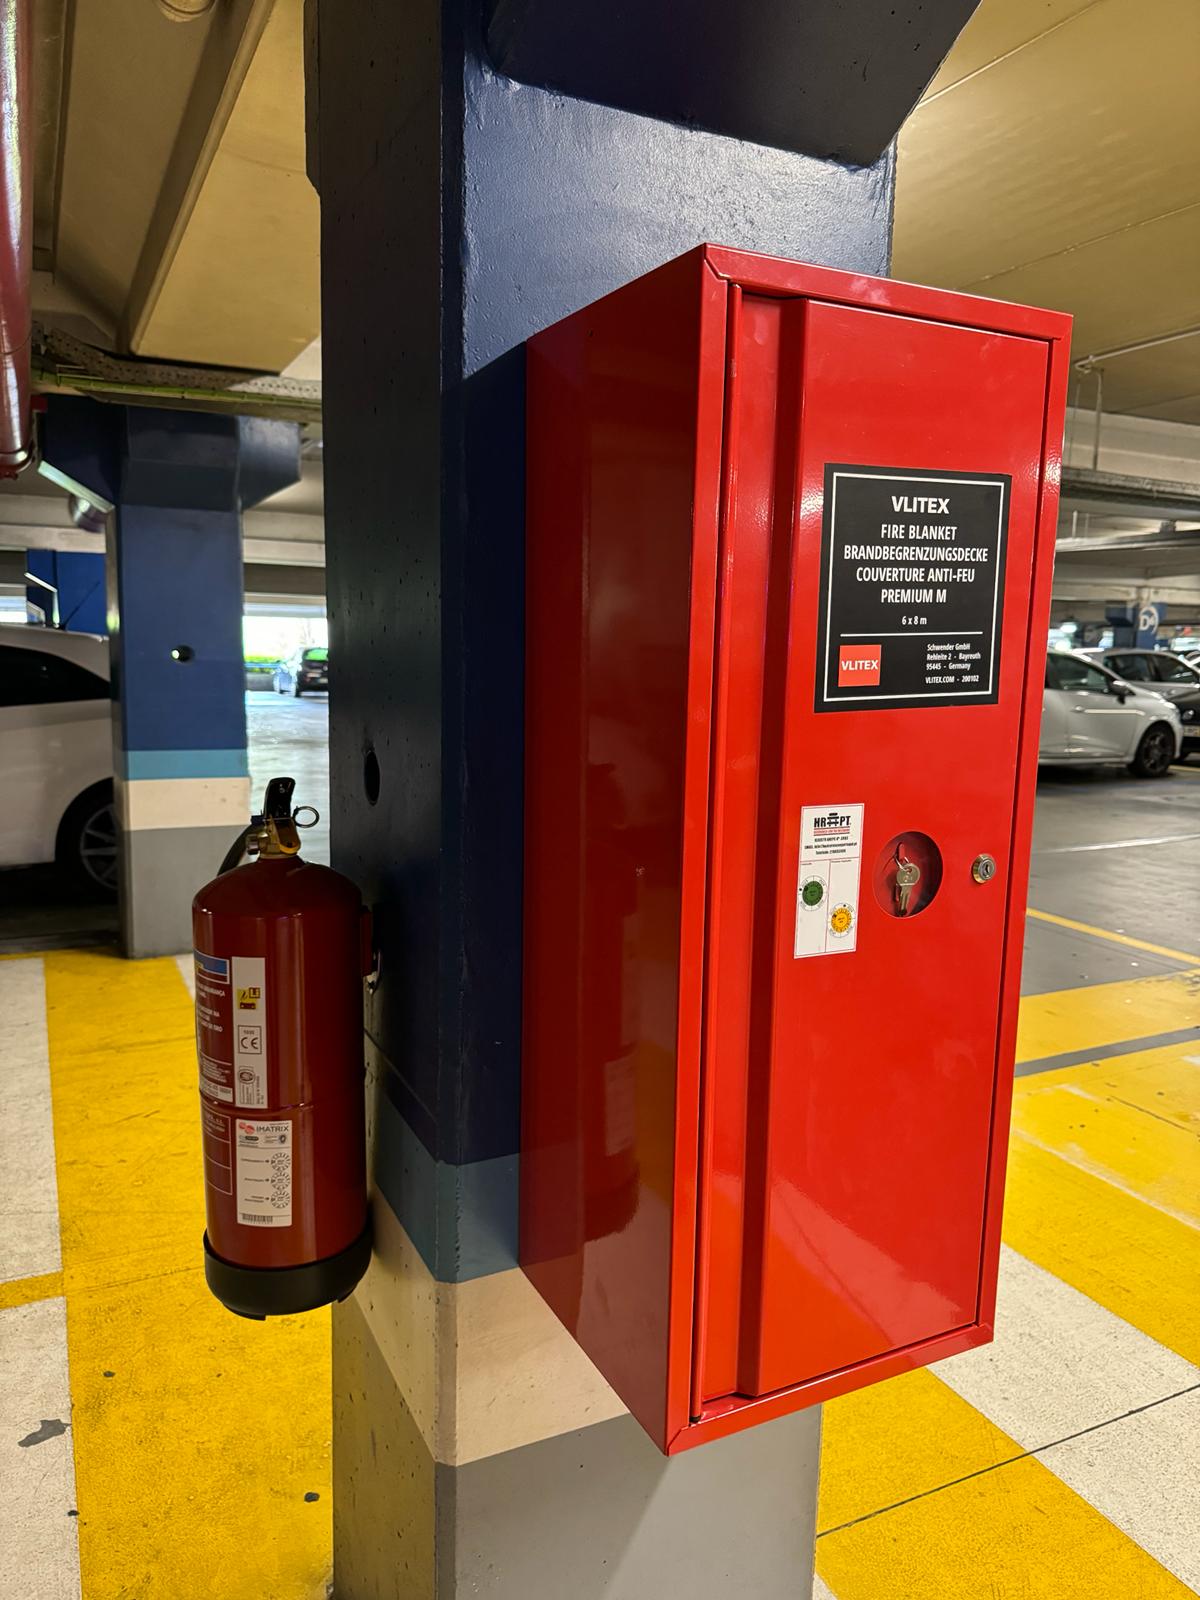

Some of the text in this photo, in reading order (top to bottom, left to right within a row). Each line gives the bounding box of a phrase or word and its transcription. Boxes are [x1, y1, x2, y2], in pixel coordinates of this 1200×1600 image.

[891, 495, 950, 514] VLITEX
[881, 524, 957, 540] FIRE BLANKET
[844, 545, 989, 562] BRANDBEGRENZUNGSDECKE
[856, 567, 975, 583] COUVERTURE ANTI-FEU
[881, 589, 947, 603] PREMIUM M
[902, 616, 927, 625] 6 x 8 m
[927, 643, 954, 651] Schwender
[959, 652, 981, 661] Bayreuth
[841, 660, 879, 671] VLITEX
[949, 663, 971, 671] Germany
[925, 676, 955, 684] VLITEX.COM
[240, 1036, 259, 1050] CE
